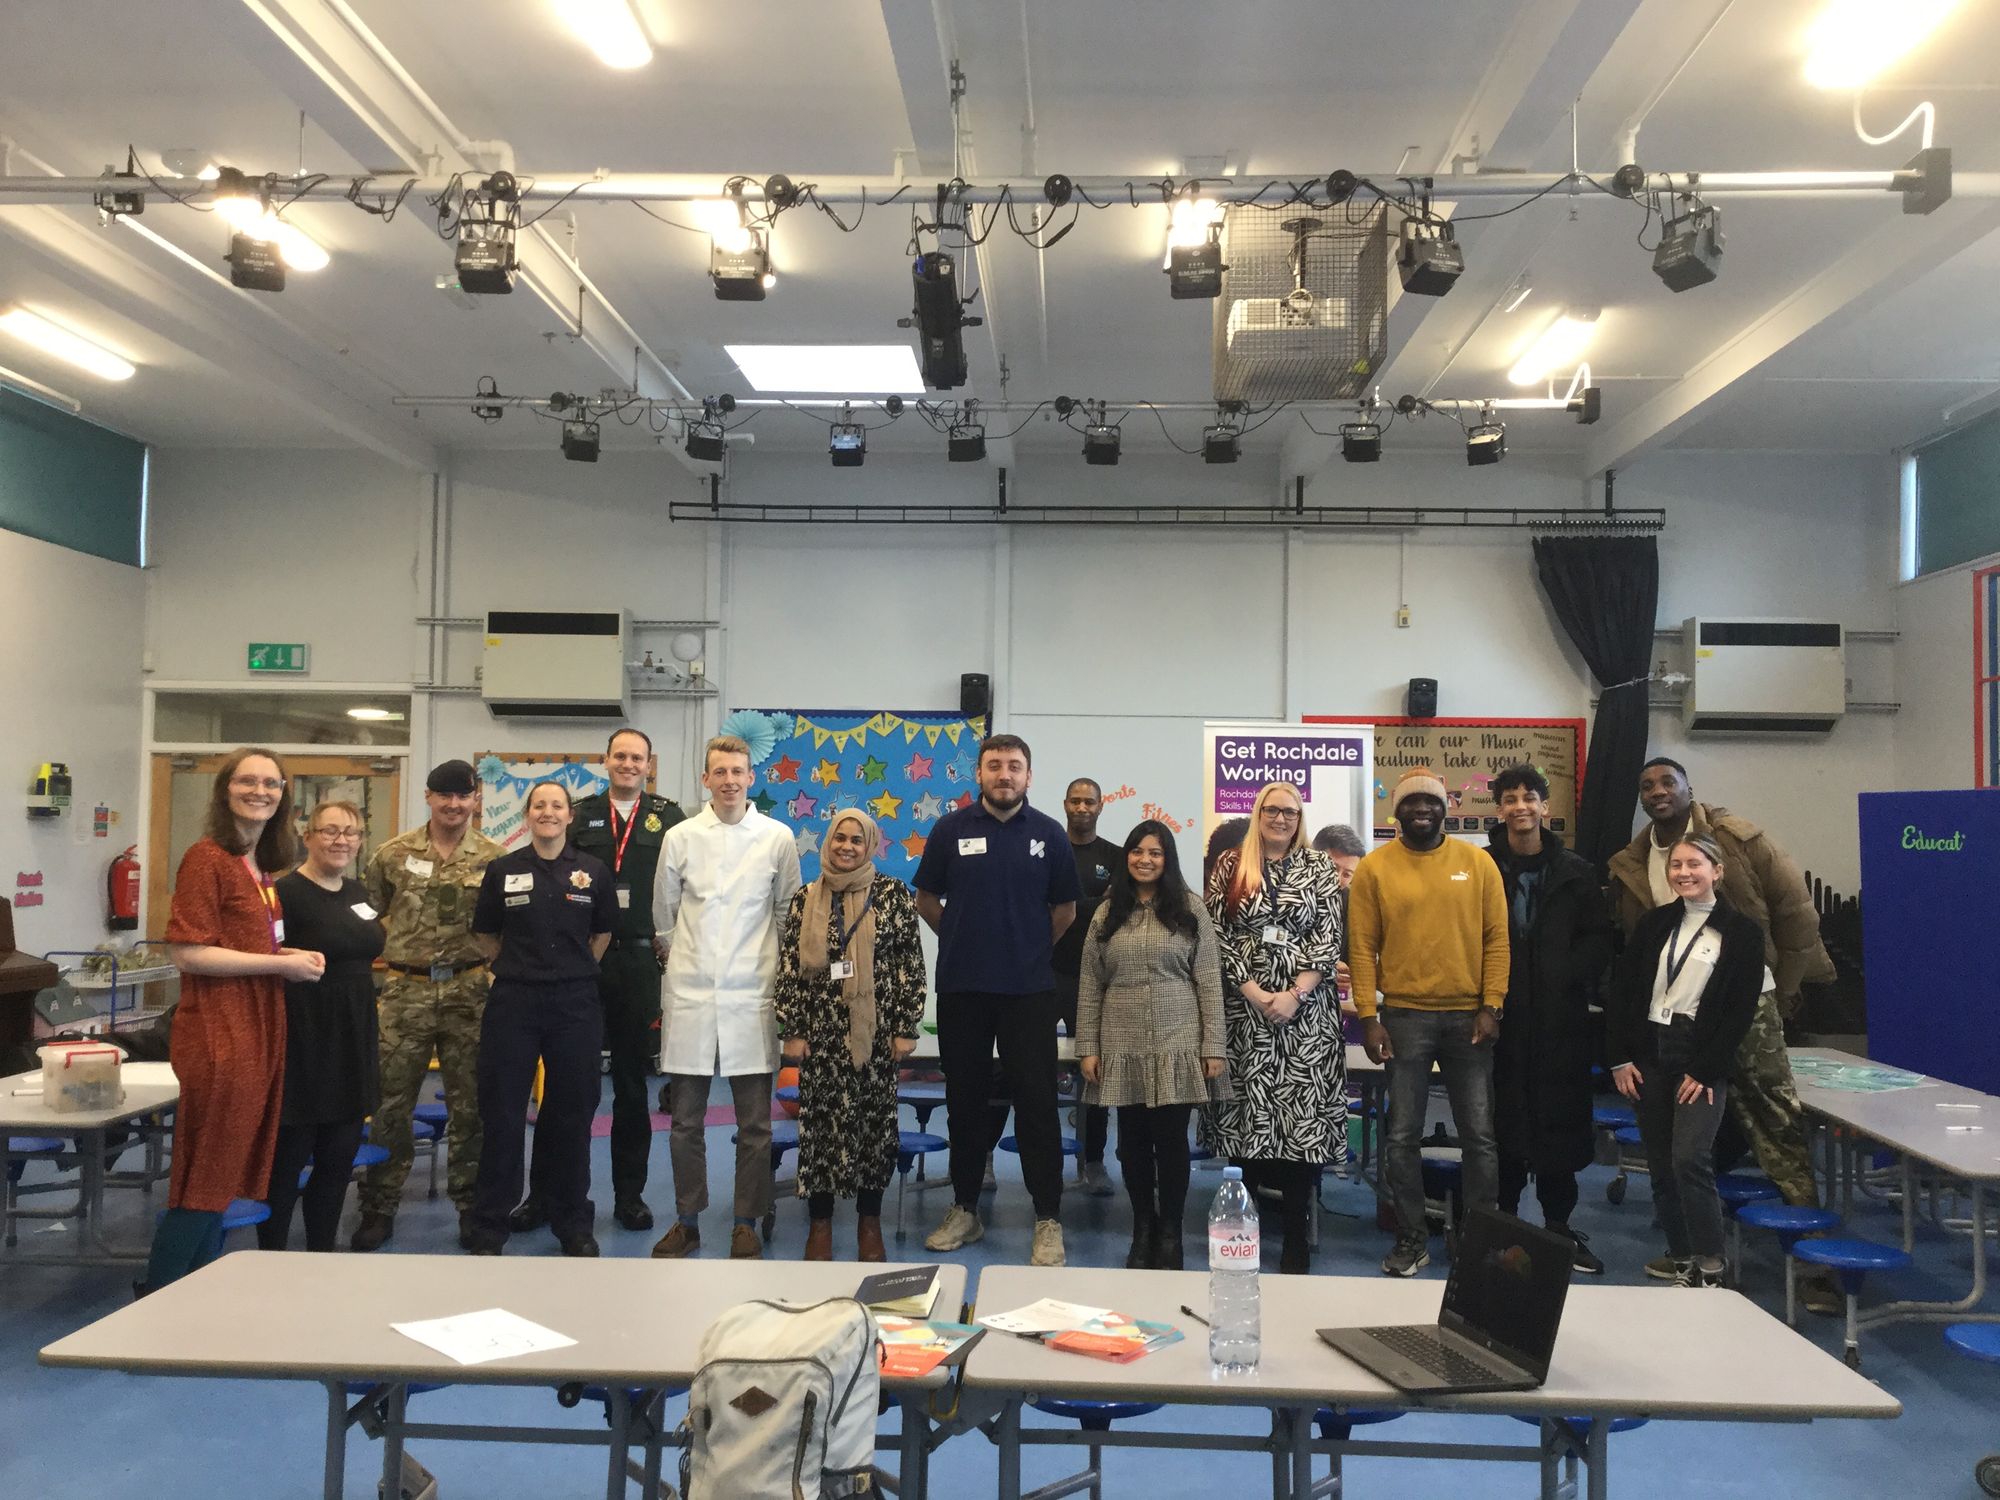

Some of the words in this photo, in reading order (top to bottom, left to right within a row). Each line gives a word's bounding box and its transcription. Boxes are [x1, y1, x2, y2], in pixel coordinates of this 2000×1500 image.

[1395, 735, 1429, 748] can
[1439, 735, 1470, 748] our
[1481, 733, 1527, 750] Music
[1220, 740, 1257, 759] Get
[1264, 742, 1358, 761] Rochdale
[1443, 751, 1480, 768] take
[1220, 763, 1306, 786] Working
[1219, 801, 1241, 810] Skills
[588, 819, 605, 828] NHS
[1220, 1243, 1257, 1257] evian
